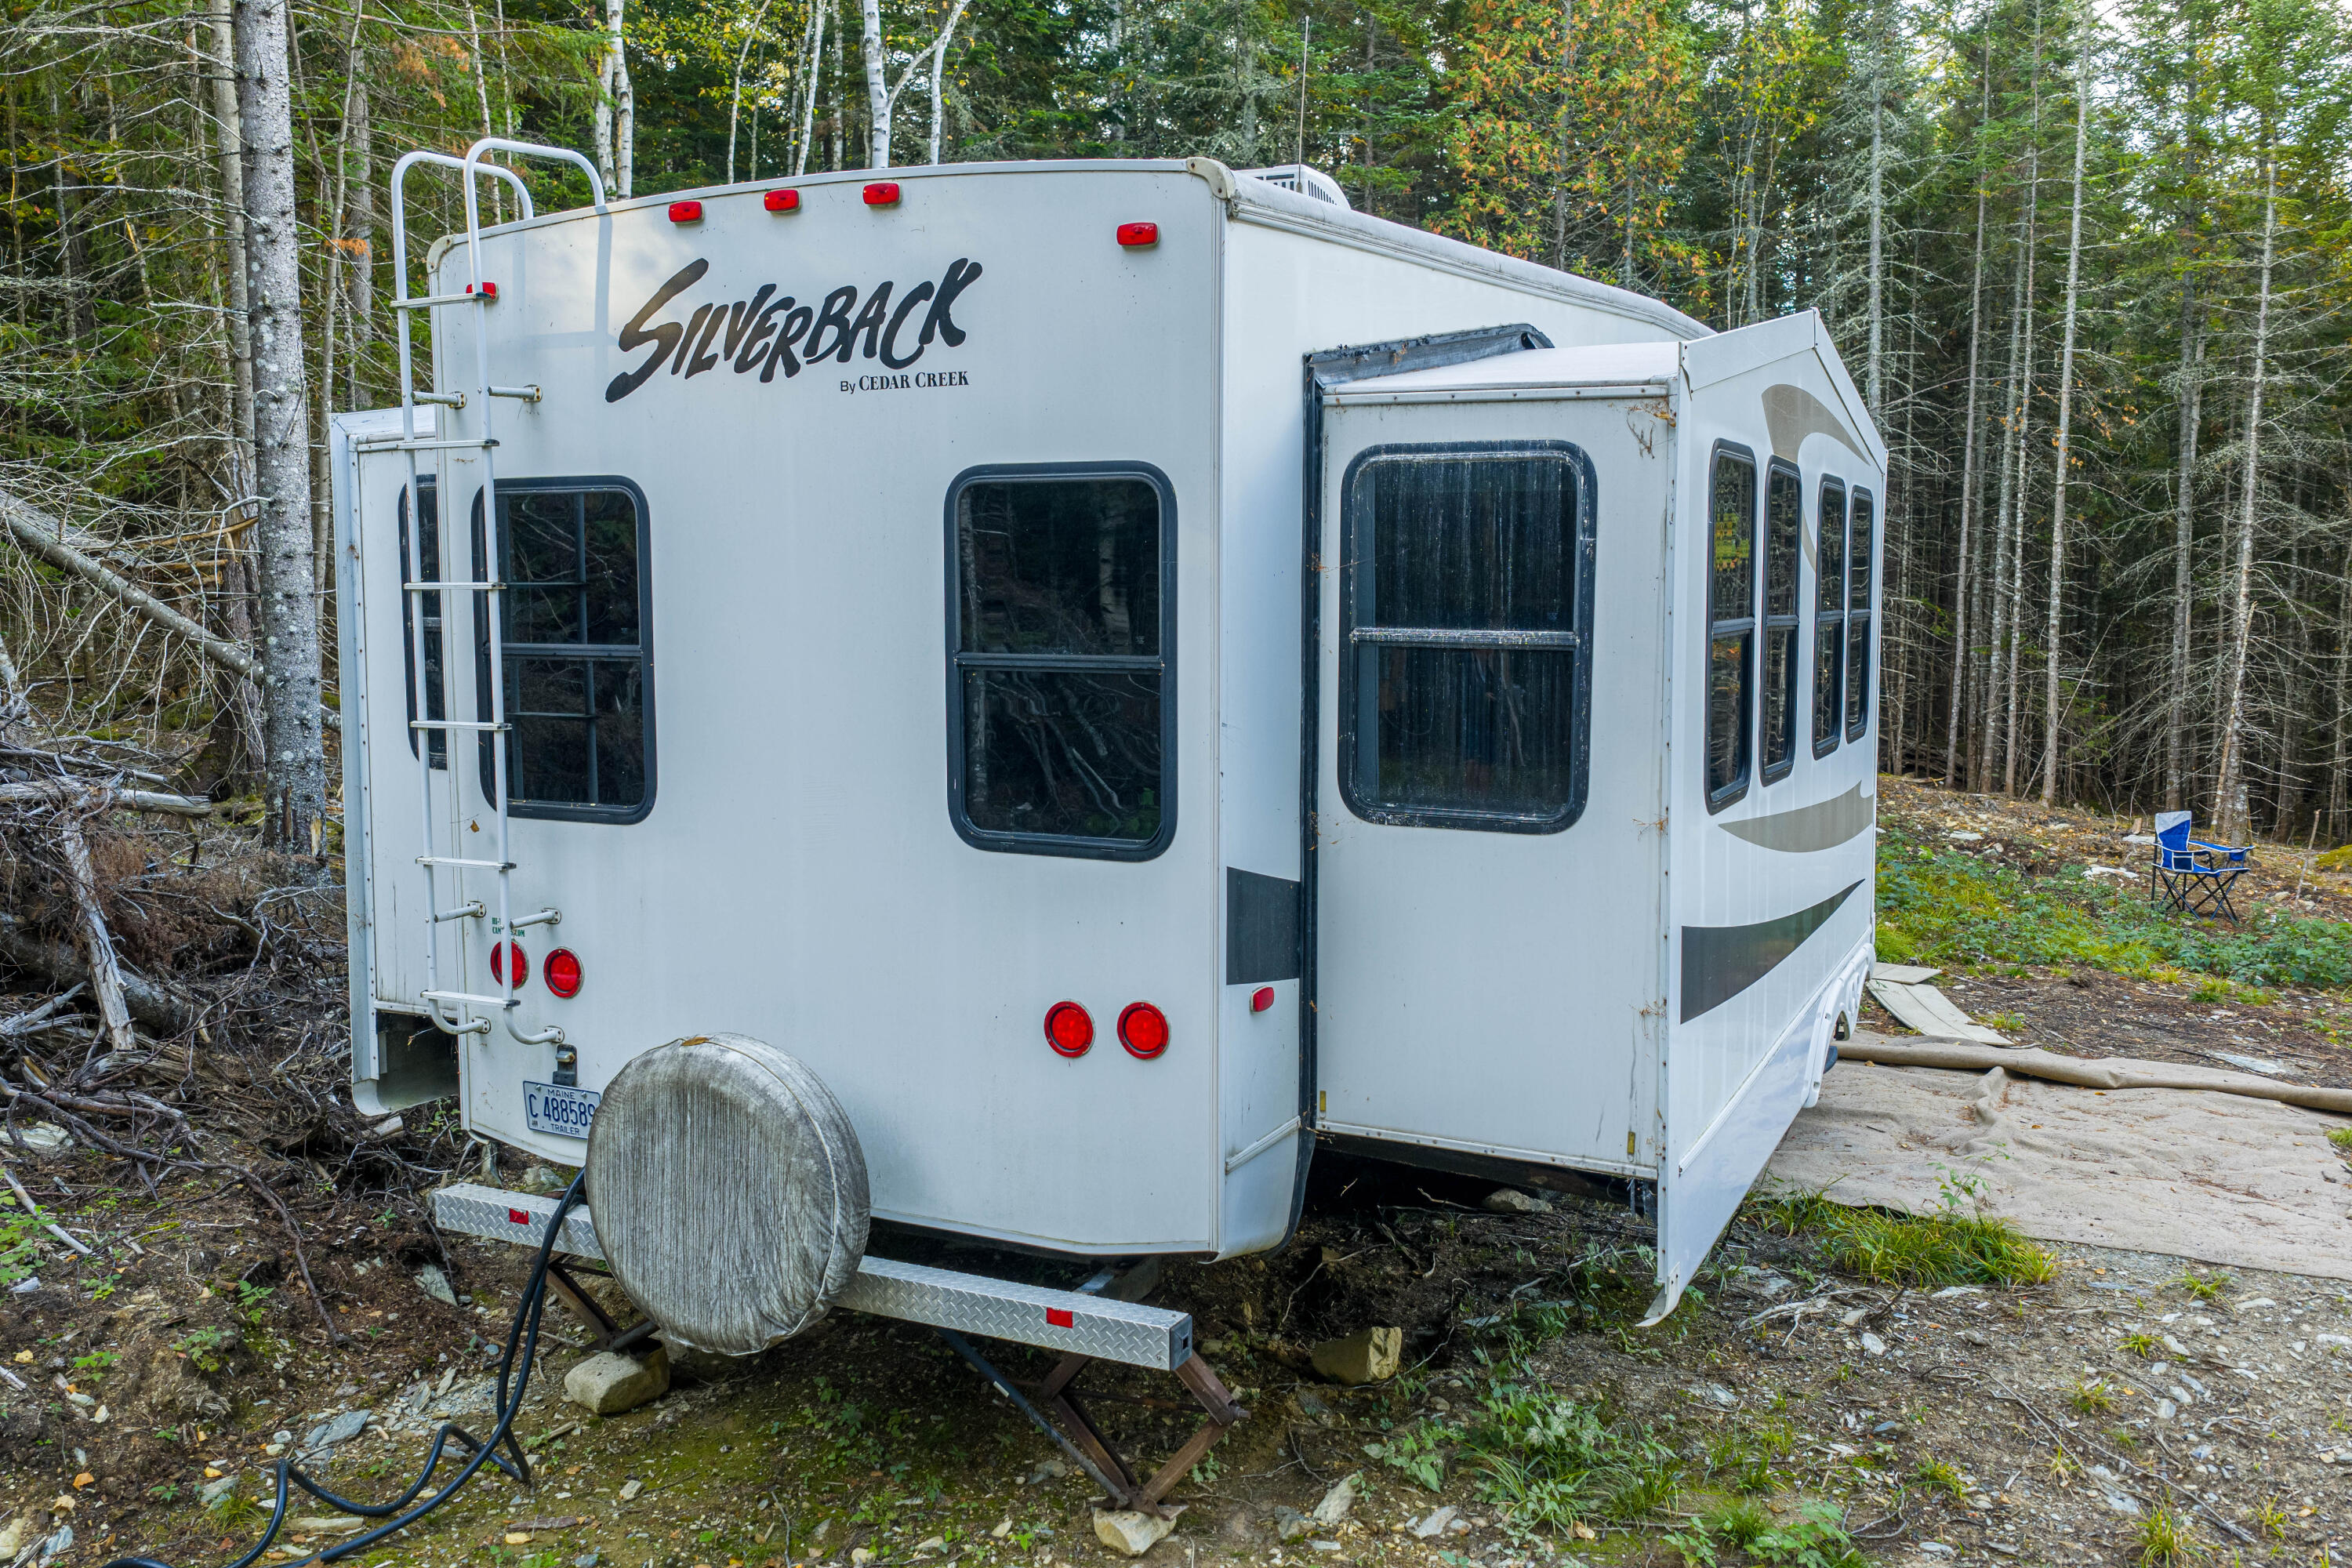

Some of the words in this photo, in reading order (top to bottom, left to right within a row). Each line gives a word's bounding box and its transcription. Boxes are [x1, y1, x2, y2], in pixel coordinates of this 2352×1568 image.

[605, 257, 983, 403] SILVERBACK
[840, 380, 856, 394] By
[858, 375, 911, 391] CEDAR
[915, 371, 969, 388] CREEK
[547, 1088, 575, 1100] MAINE
[528, 1094, 539, 1118] C
[550, 1123, 580, 1135] TRAILER
